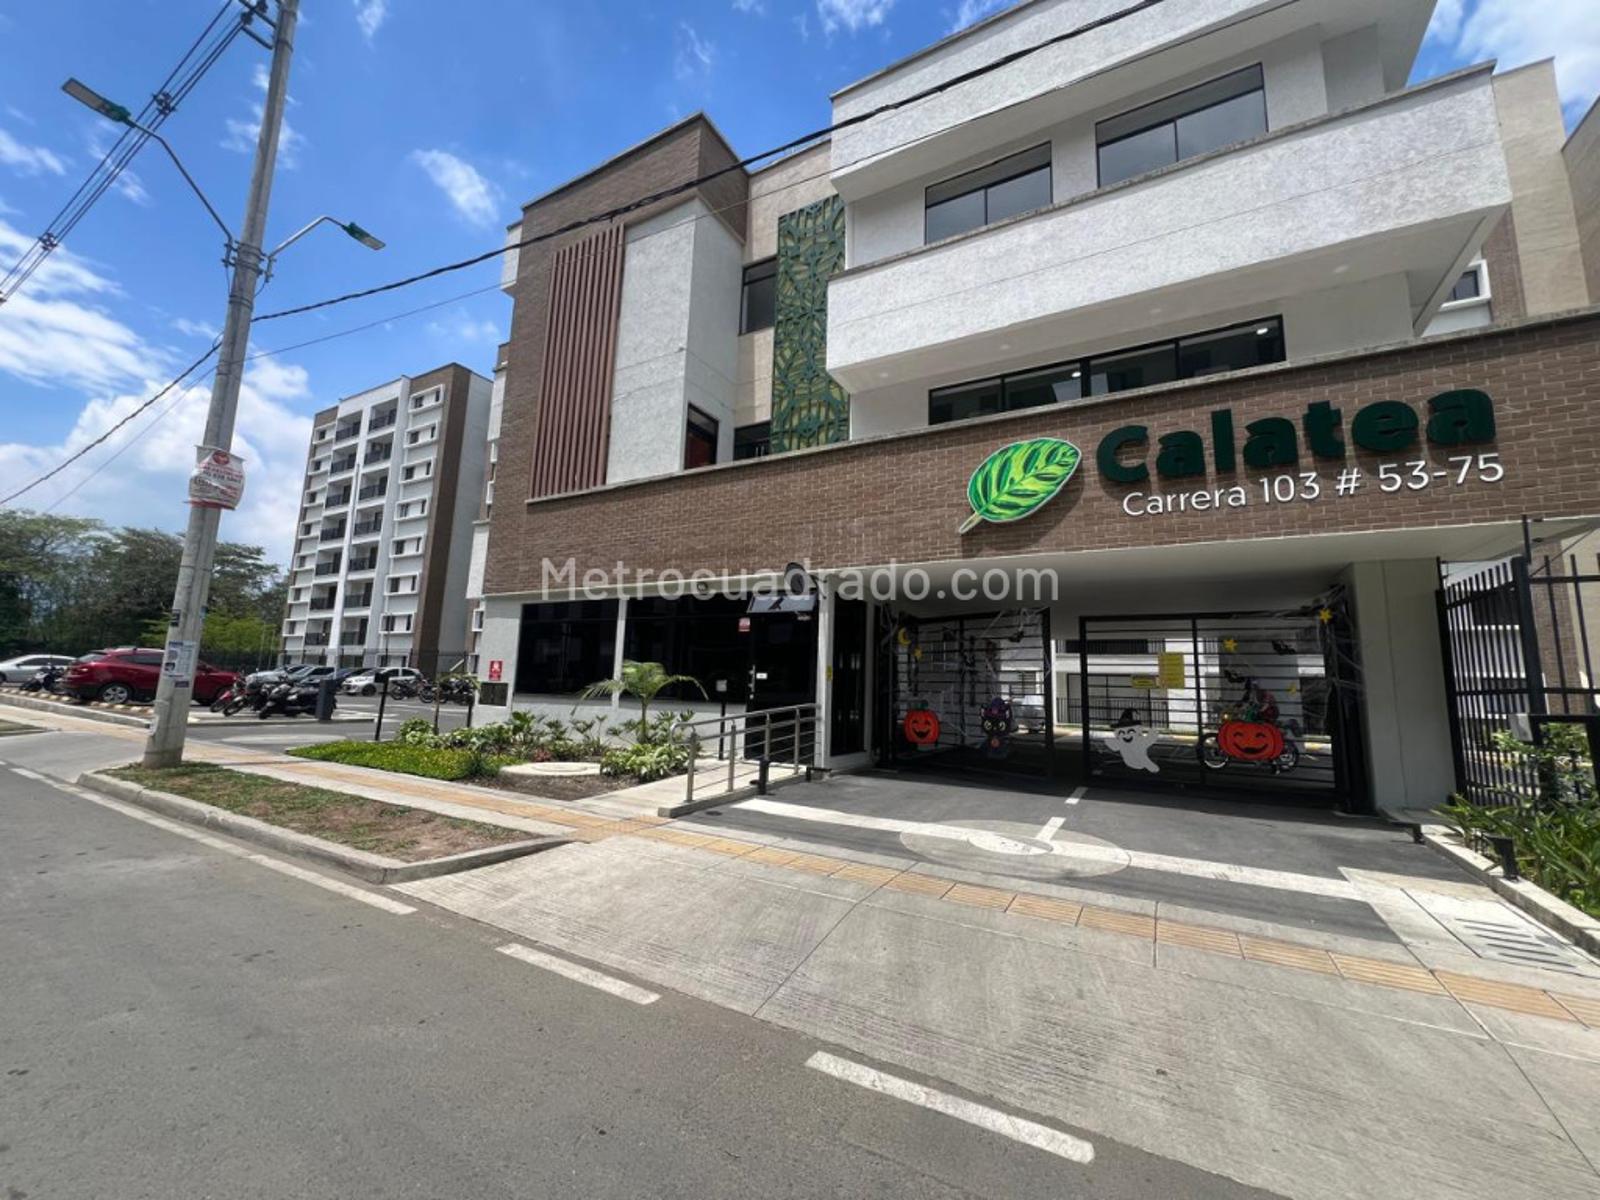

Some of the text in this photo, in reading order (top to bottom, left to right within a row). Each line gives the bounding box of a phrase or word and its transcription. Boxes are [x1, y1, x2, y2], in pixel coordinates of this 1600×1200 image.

[1096, 389, 1496, 482] Calatea
[1123, 453, 1504, 516] Carrera 103 # 53-75
